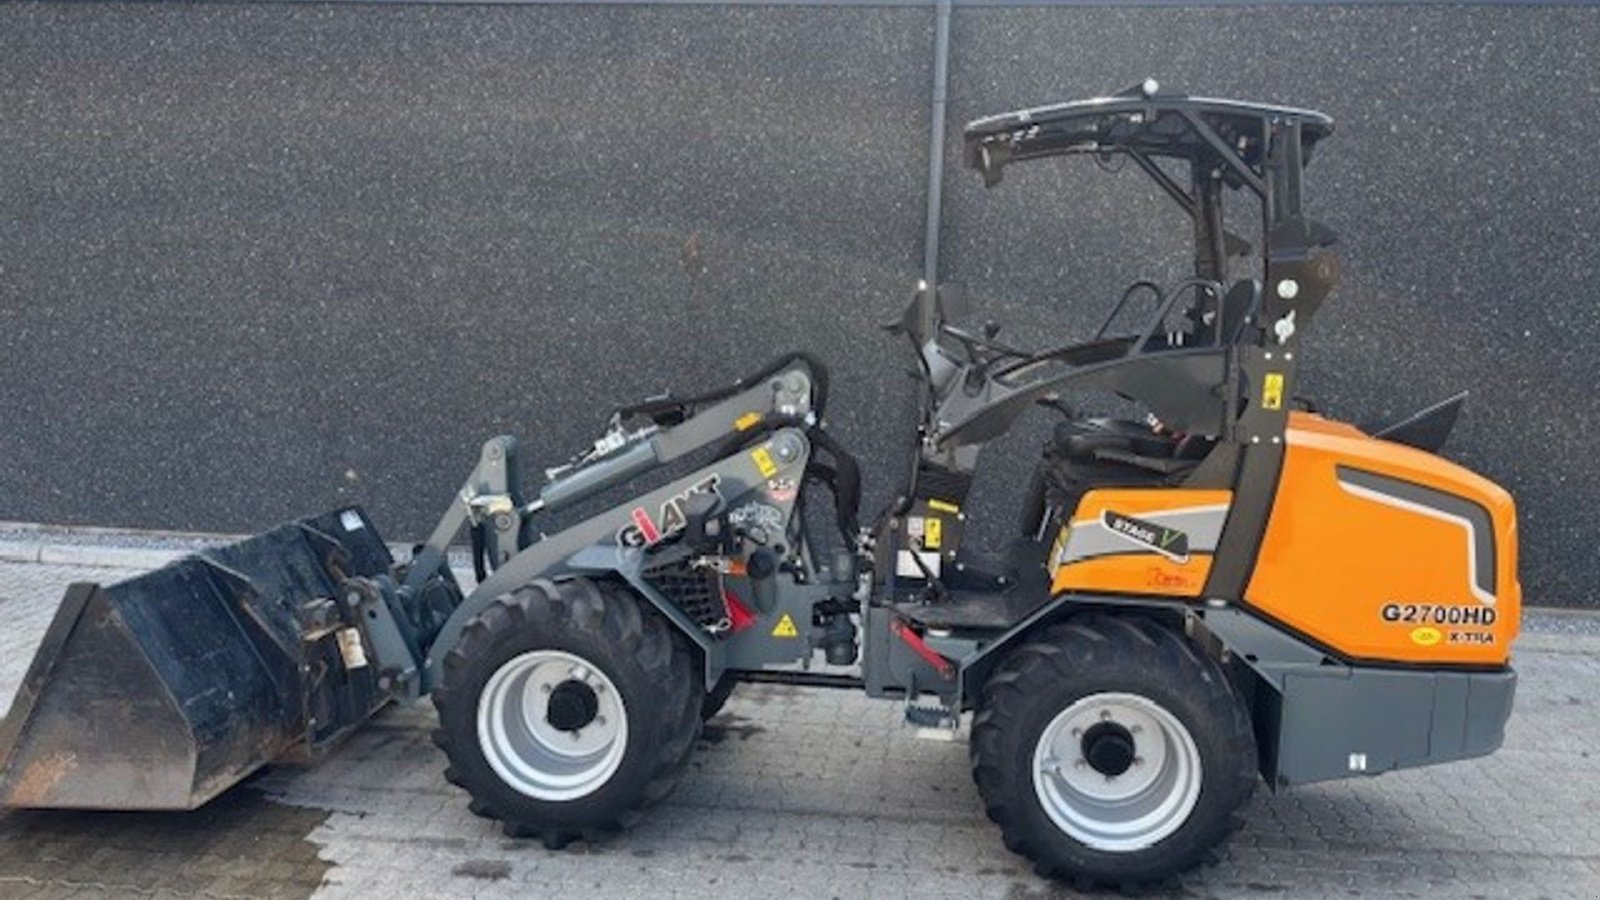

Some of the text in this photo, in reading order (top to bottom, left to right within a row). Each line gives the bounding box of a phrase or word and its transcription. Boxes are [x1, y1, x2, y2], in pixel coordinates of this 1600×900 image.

[617, 474, 720, 548] GIAT
[1113, 518, 1184, 549] STAGE V
[1381, 603, 1497, 626] G2700HD
